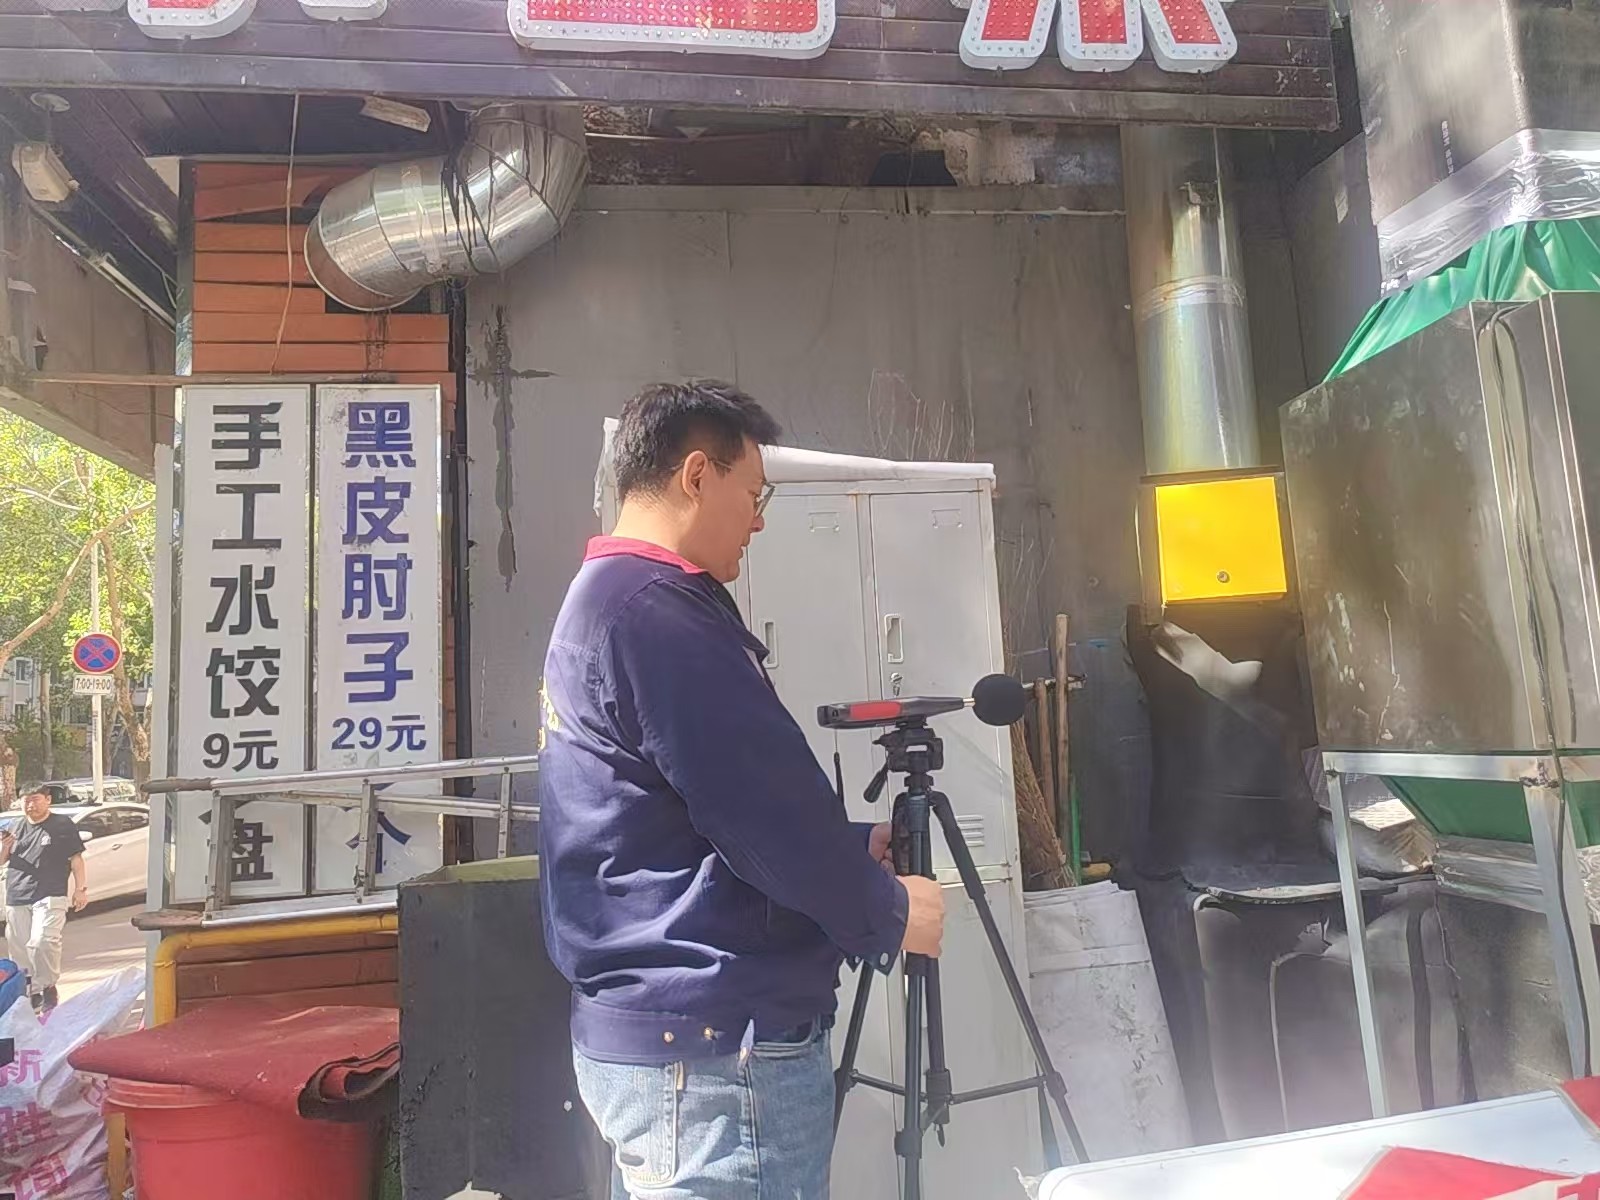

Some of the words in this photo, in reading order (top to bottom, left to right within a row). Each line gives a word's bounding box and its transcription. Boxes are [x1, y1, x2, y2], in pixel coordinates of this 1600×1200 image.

[206, 402, 283, 718] 手工水饺
[342, 402, 416, 703] 黑皮肘子
[202, 730, 279, 772] 9元
[331, 715, 427, 752] 29元
